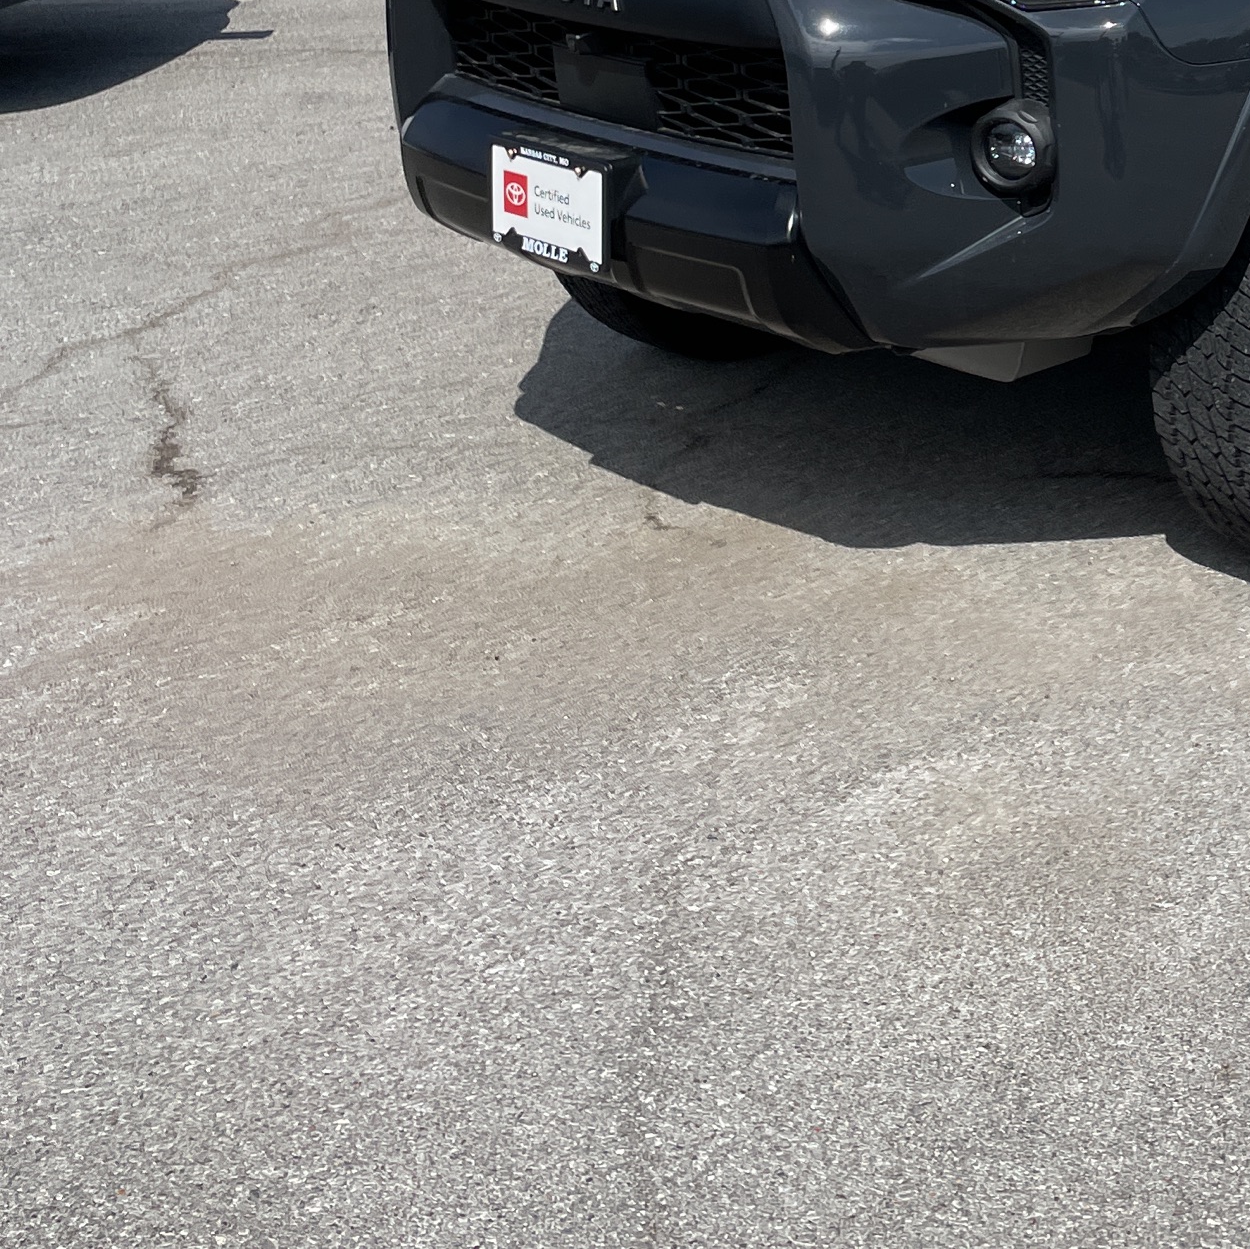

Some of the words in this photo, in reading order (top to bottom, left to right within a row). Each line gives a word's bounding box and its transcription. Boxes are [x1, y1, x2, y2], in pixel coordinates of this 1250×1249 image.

[558, 156, 570, 167] MO
[534, 185, 570, 206] Certified
[534, 203, 555, 219] Used
[557, 209, 592, 230] Vehicles
[521, 236, 569, 263] MOLLE
